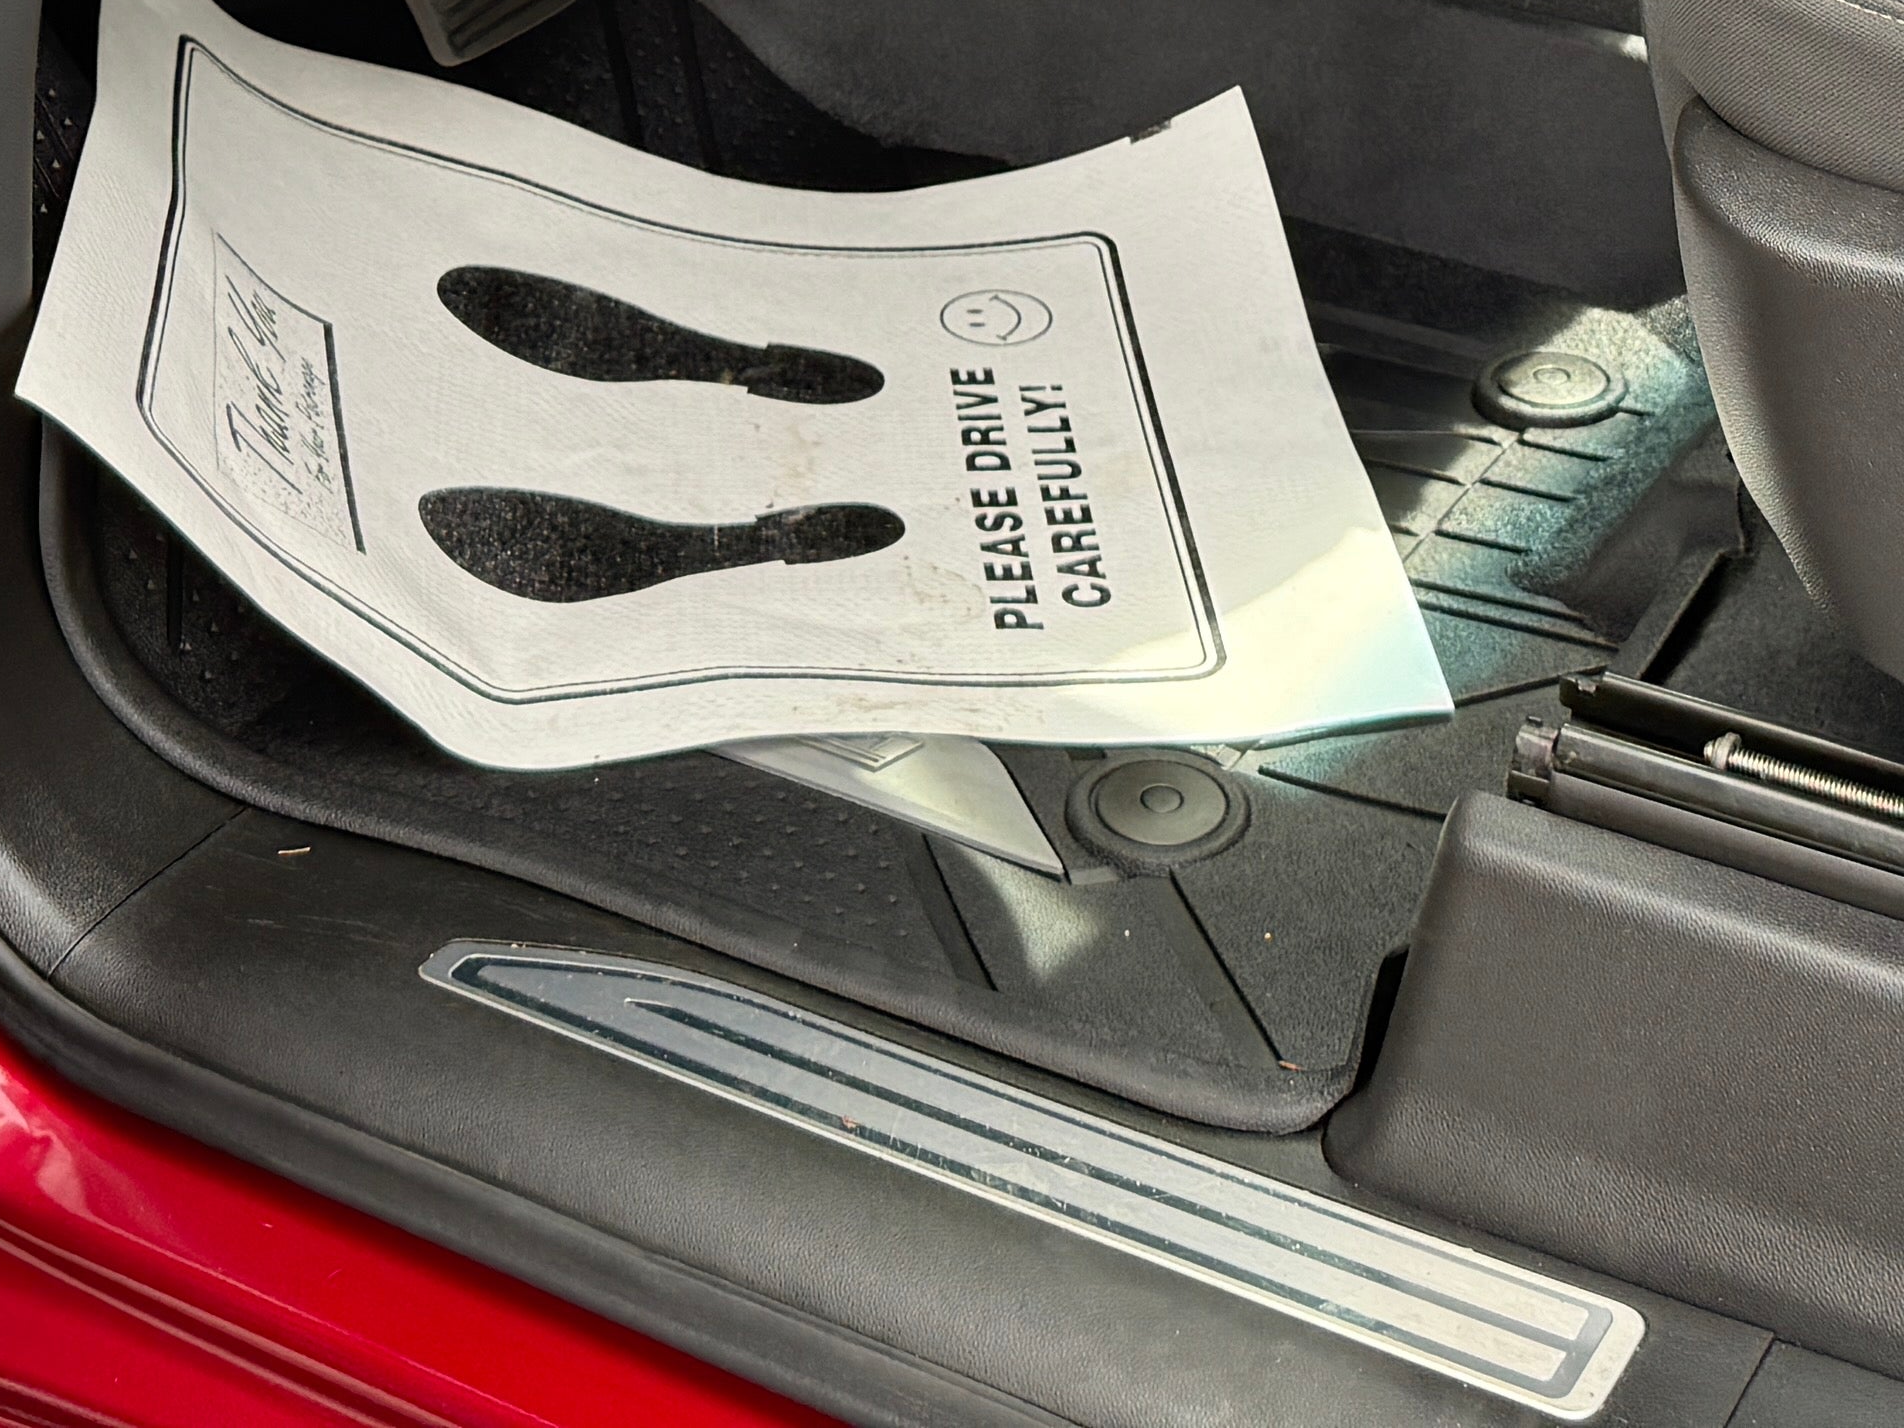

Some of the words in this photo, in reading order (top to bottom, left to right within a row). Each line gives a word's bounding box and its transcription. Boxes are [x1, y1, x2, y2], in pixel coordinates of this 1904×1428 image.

[224, 274, 287, 363] You
[225, 325, 303, 495] Thank
[950, 367, 1012, 472] DRIVE
[970, 487, 1044, 630] PLEASE
[1019, 384, 1112, 608] CAREFULLY!
